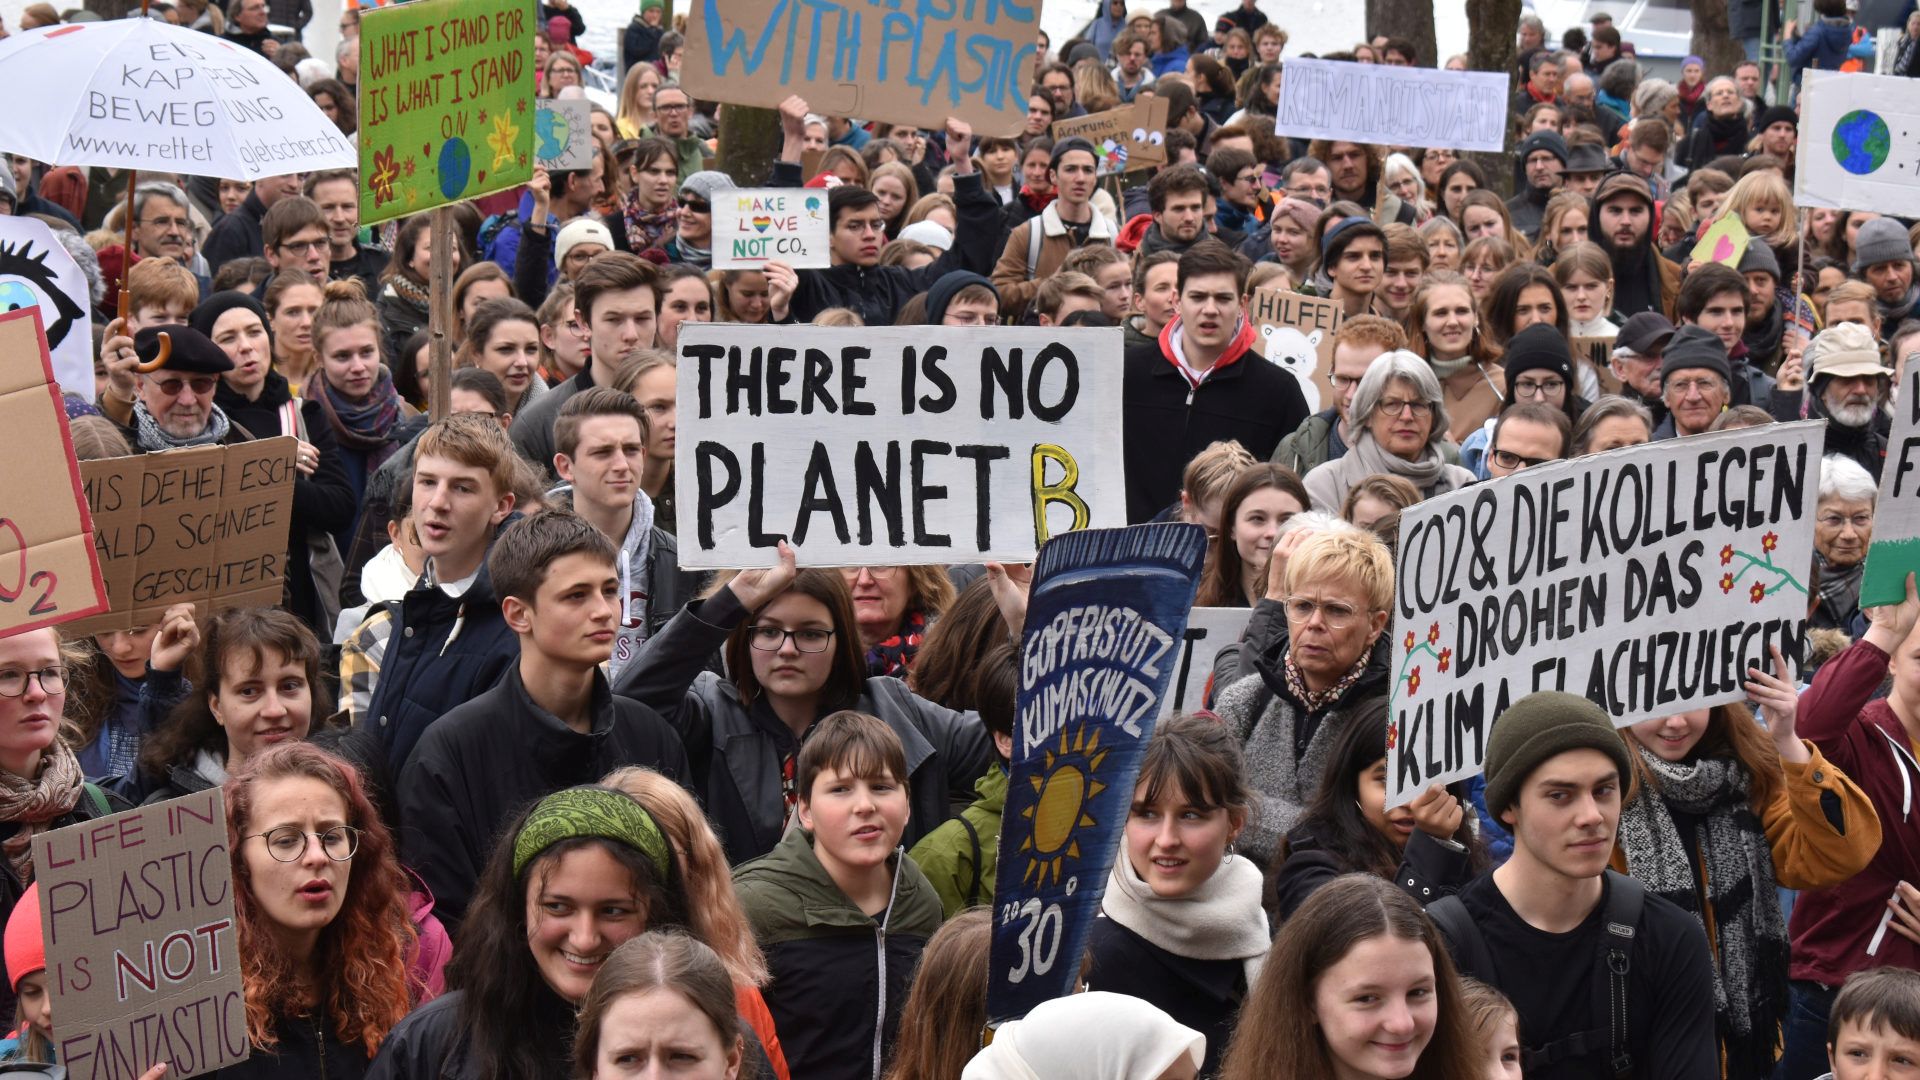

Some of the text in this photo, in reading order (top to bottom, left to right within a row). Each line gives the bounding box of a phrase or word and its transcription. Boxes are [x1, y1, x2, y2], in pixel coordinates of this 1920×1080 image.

[150, 41, 206, 61] EIS
[370, 8, 525, 80] WHAT I STAND FOR
[703, 0, 1039, 117] WITH PLASTIC
[369, 50, 523, 126] IS WHAT I STAND
[440, 111, 469, 139] ON
[1281, 66, 1503, 144] KLIMANOTSTAND
[537, 145, 577, 169] ANET
[737, 196, 786, 212] MAKE
[733, 237, 773, 257] NOT
[1258, 292, 1338, 336] HILFE!
[682, 341, 1080, 423] THERE IS NO
[141, 464, 225, 508] DEHEI
[239, 455, 298, 491] ESCH
[694, 439, 1091, 552] PLANET B
[1508, 478, 1574, 586] DIE
[1580, 443, 1808, 564] KOLLEGEN
[95, 501, 278, 562] ALD SCHNEE
[132, 554, 277, 603] GESCHTER
[1455, 539, 1705, 678] DROHEN DAS
[1023, 604, 1174, 691] GOPFRISTUTZ
[1022, 667, 1157, 760] KLIMASCHUTZ
[47, 796, 214, 869] LIFE IN
[48, 844, 227, 945] PLASTIC
[57, 918, 232, 1001] IS NOT
[62, 991, 245, 1080] FANTASTIC
